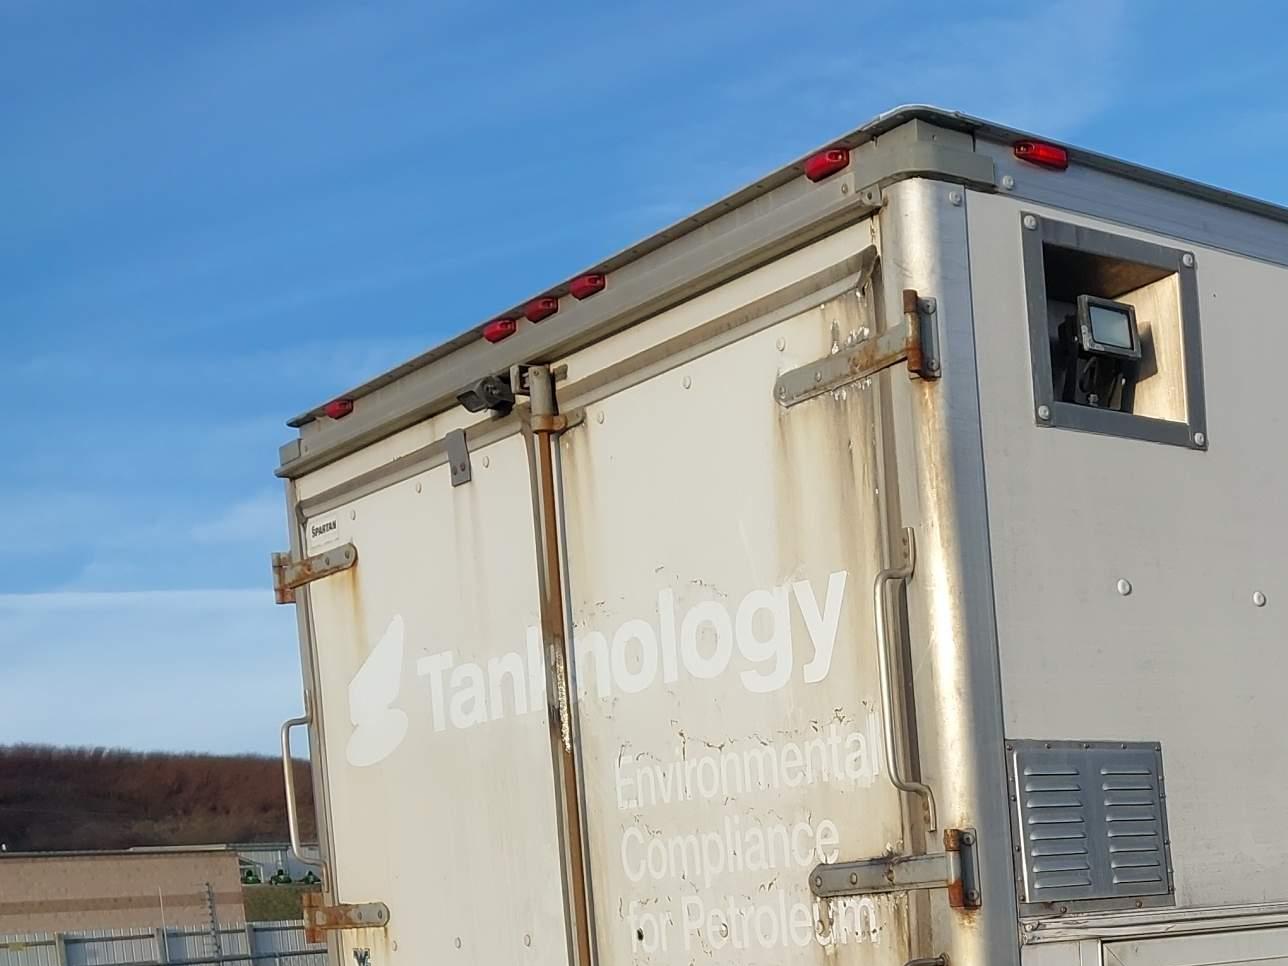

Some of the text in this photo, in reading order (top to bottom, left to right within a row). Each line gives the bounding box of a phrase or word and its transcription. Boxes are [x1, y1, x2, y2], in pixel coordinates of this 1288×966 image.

[311, 519, 337, 538] SPARTAN
[615, 711, 881, 810] Environmental
[620, 815, 840, 888] Compliance
[627, 889, 880, 953] for Petroleum
